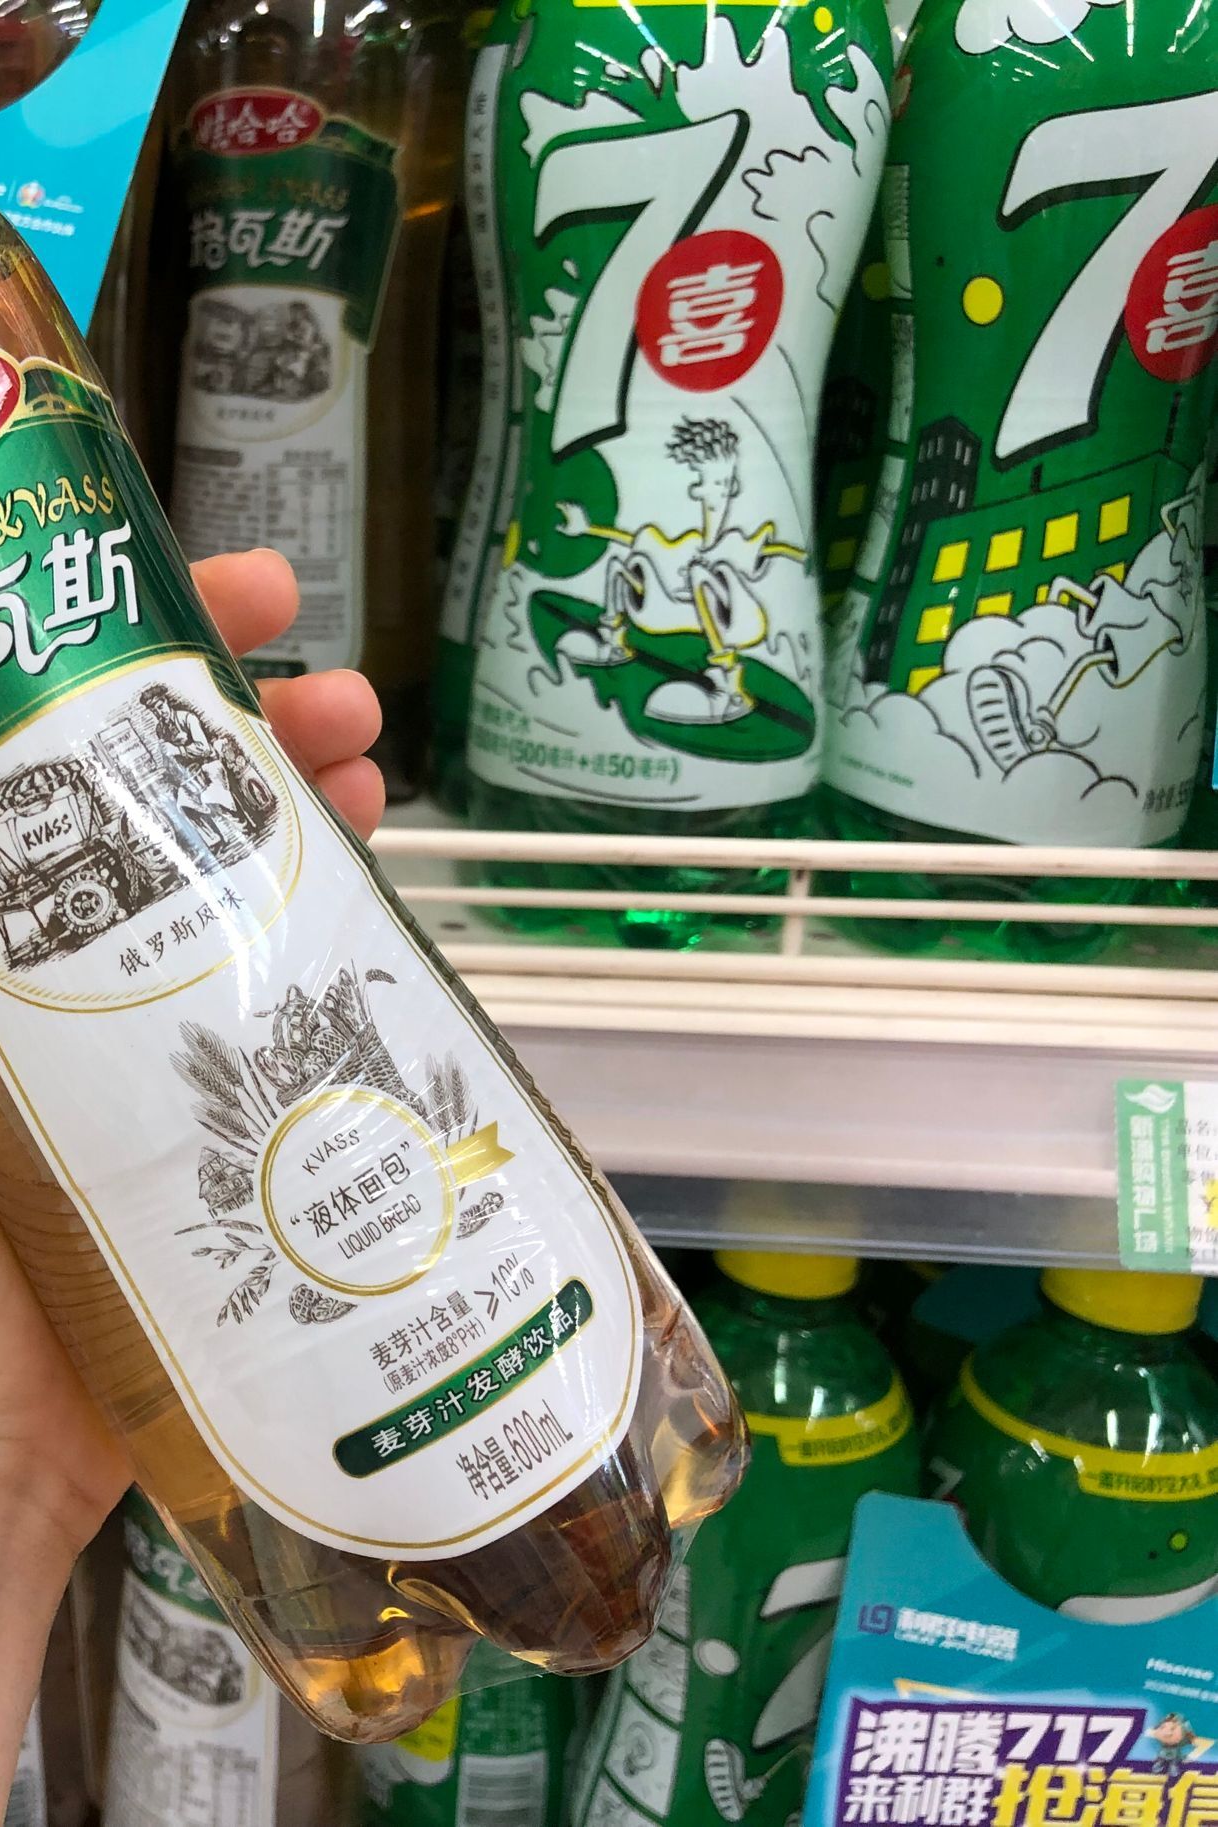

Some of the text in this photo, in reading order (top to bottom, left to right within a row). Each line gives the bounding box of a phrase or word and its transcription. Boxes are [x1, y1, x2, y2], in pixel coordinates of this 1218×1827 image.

[22, 813, 74, 851] KVASS
[118, 886, 246, 978] 俄罗斯风味
[301, 1128, 361, 1177] KVASS
[337, 1192, 423, 1261] LIQUID BREAD
[370, 1304, 576, 1458] 麦芽汁发酵饮品
[849, 1709, 1134, 1776] 沸腾717
